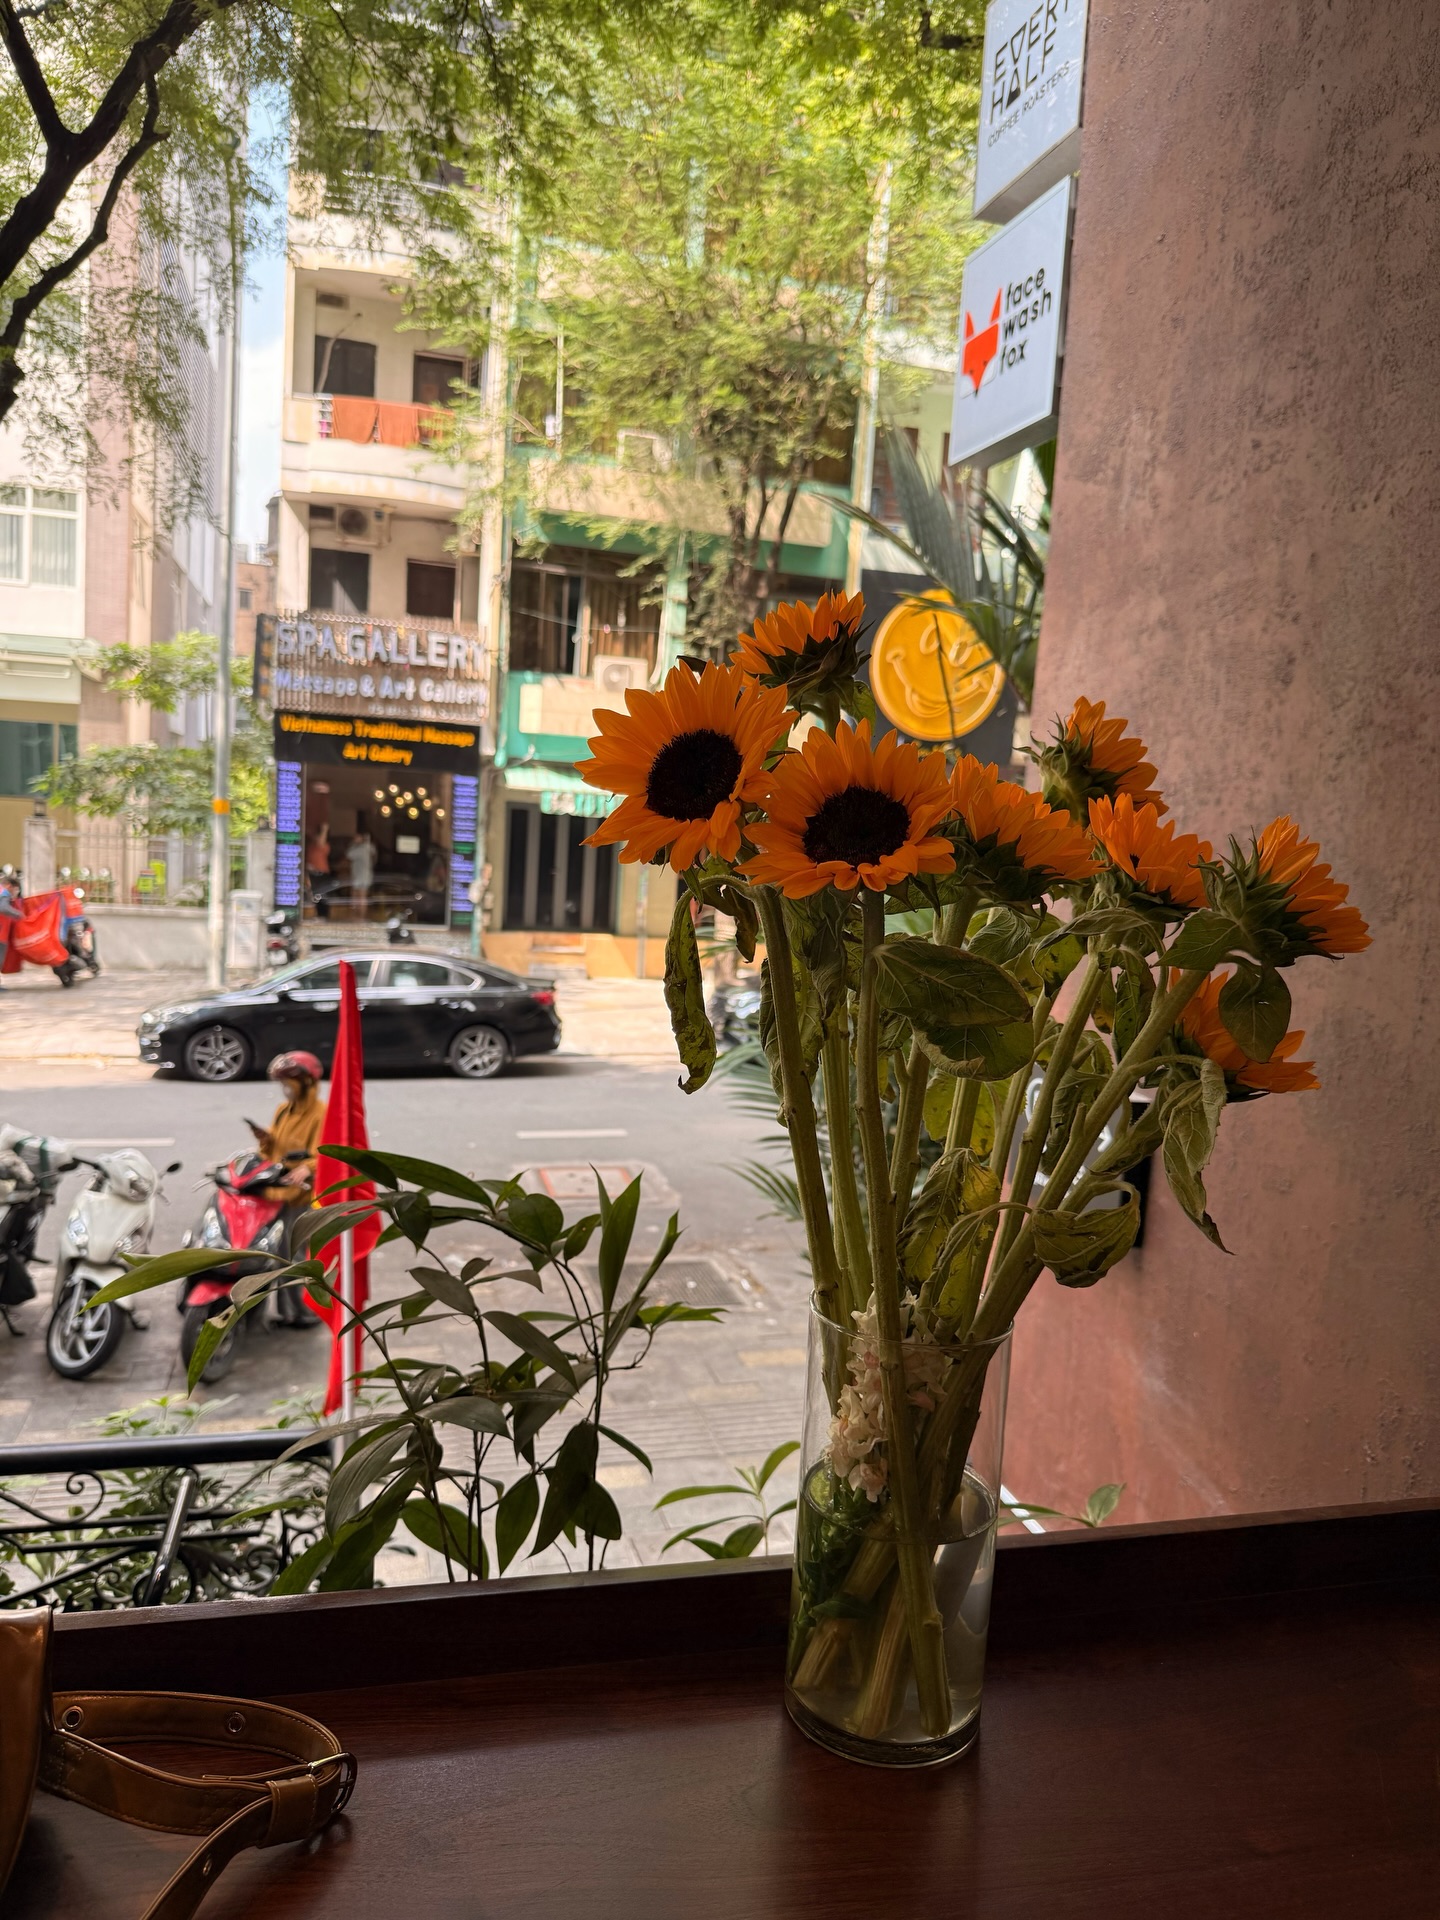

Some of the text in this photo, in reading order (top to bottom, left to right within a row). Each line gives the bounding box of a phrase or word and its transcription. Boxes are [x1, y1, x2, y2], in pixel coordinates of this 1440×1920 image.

[990, 28, 1057, 125] HALF
[1005, 267, 1046, 314] face
[1002, 288, 1052, 342] wash
[1000, 339, 1029, 374] fox
[277, 622, 338, 660] SPA
[345, 625, 487, 671] GALLERY
[275, 666, 487, 706] Massage & Art Gallery
[279, 714, 353, 737] Vietnamese
[353, 719, 423, 743] Traditional
[342, 741, 414, 767] Art Gallery
